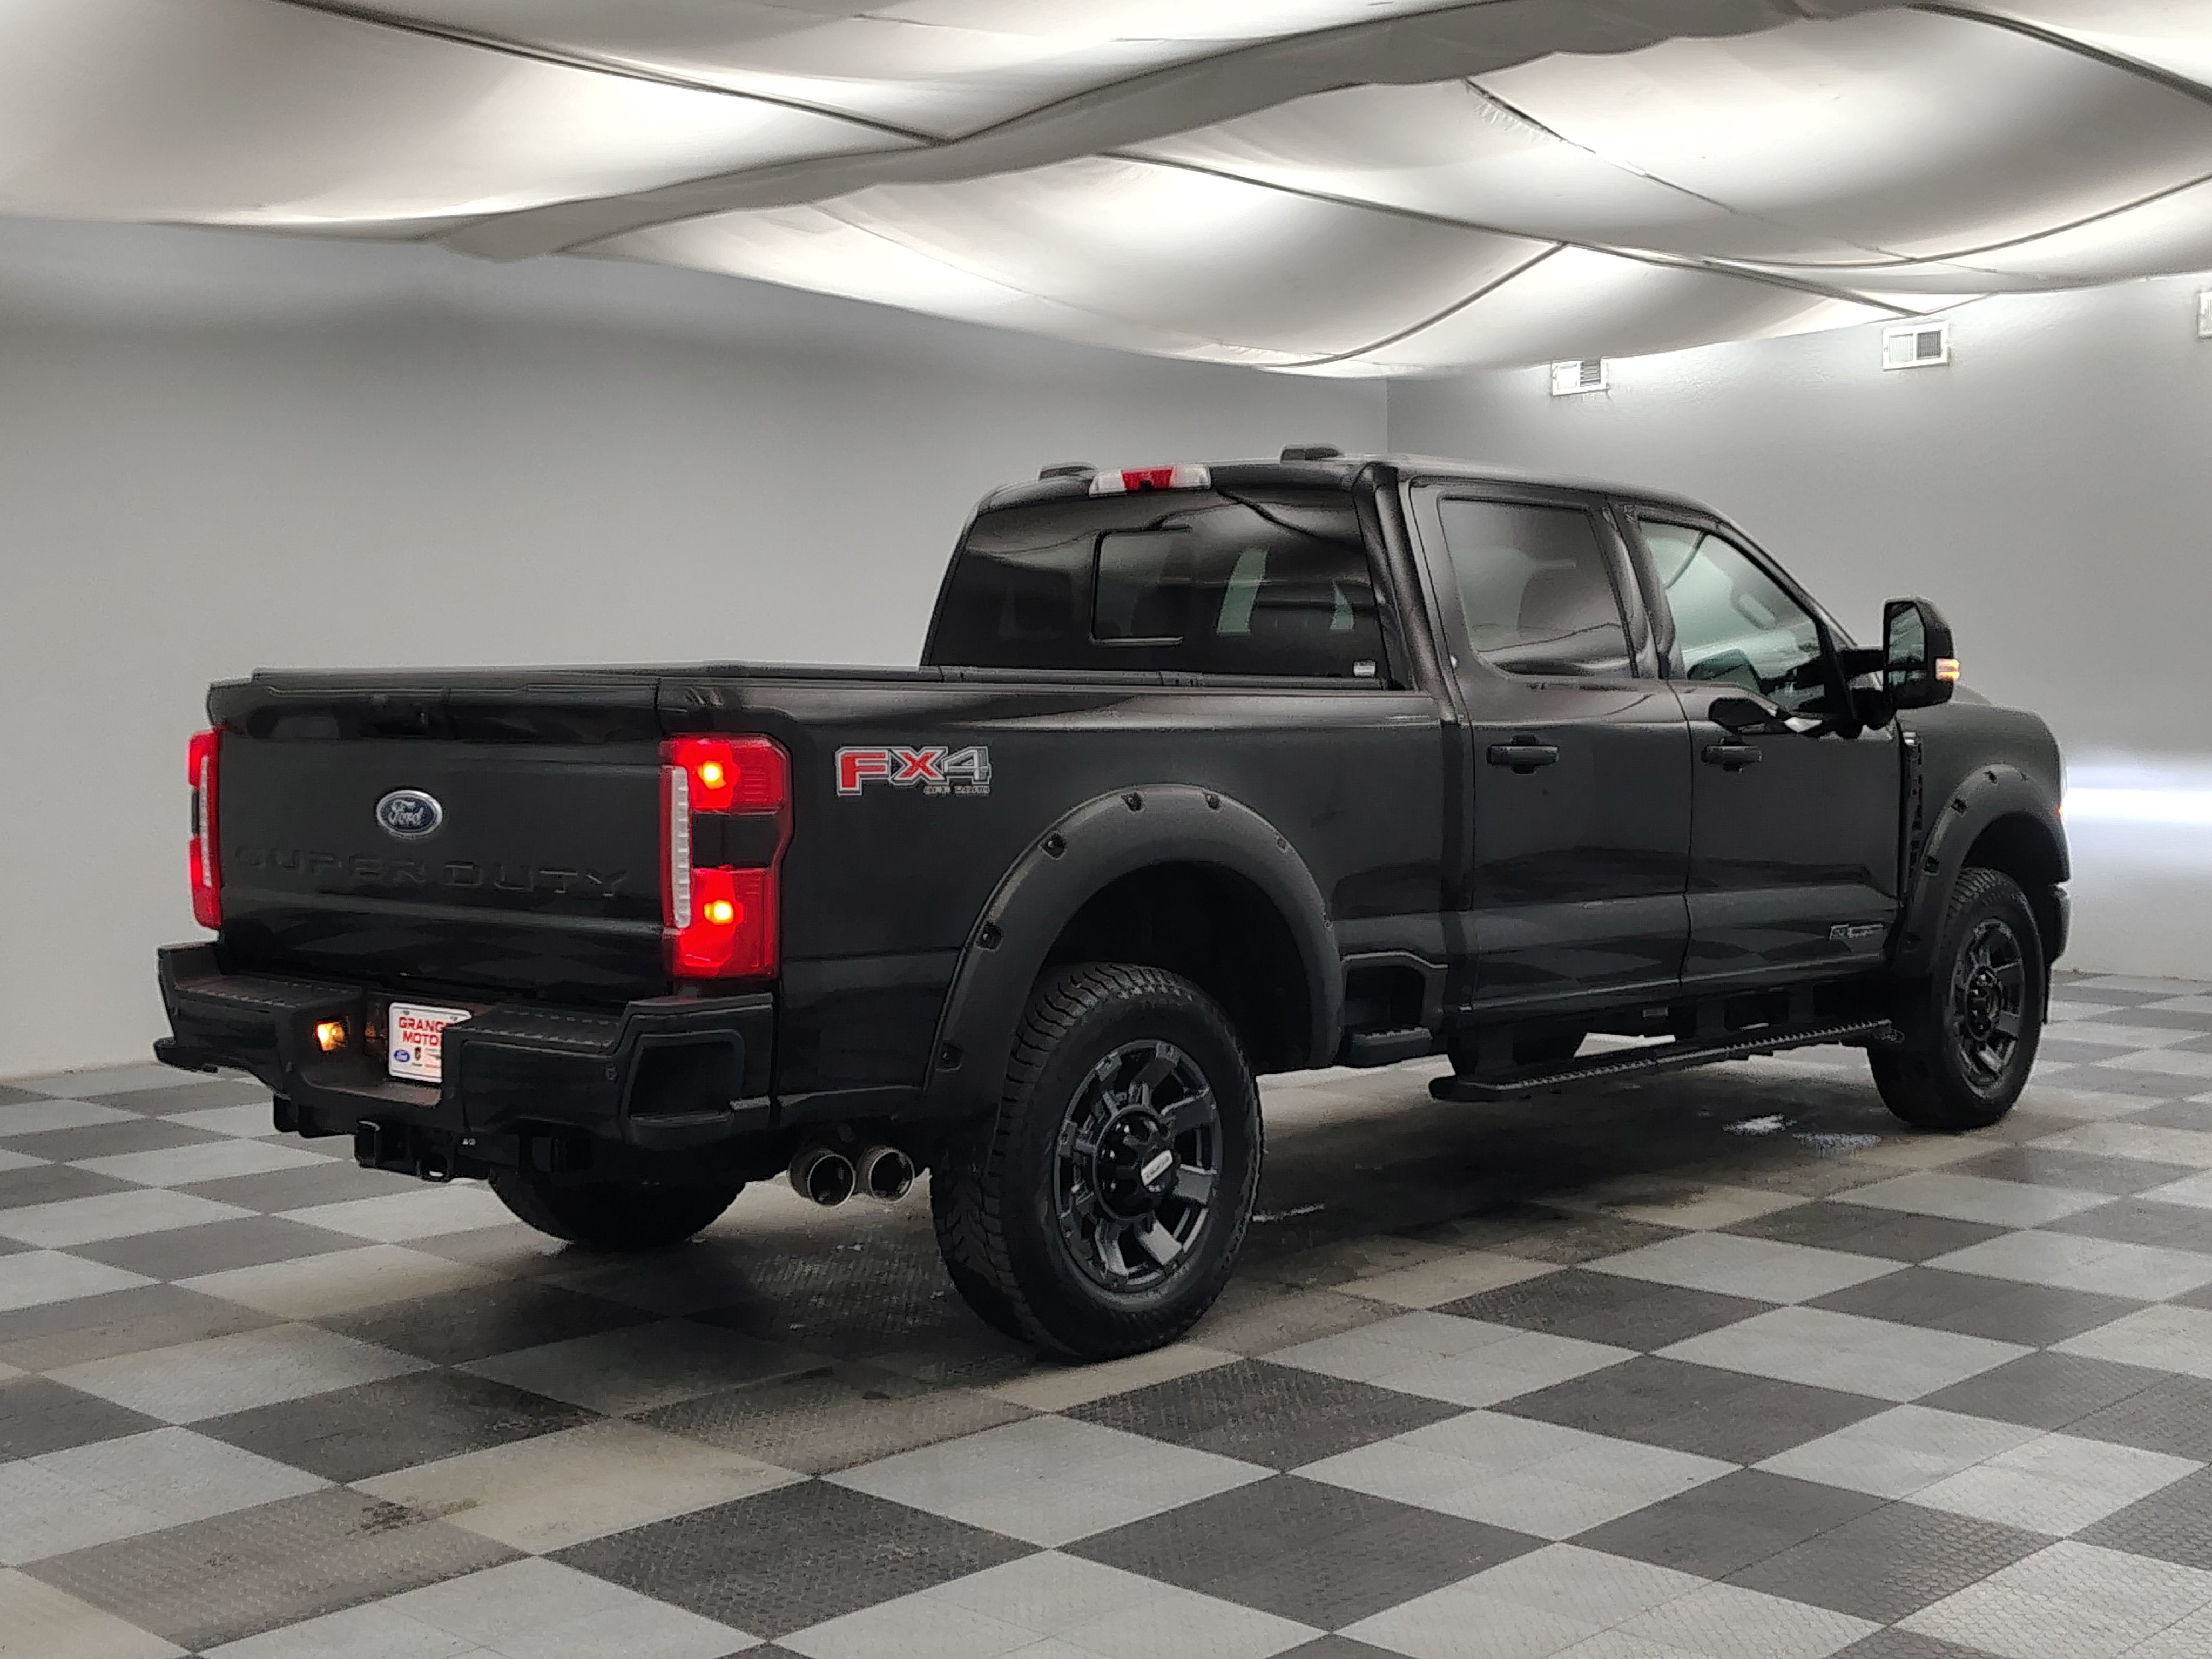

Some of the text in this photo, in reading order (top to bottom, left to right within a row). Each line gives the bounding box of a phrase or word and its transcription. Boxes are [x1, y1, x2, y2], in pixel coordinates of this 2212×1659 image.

[835, 746, 991, 797] FX4
[388, 799, 424, 827] Ford
[236, 845, 628, 898] SUPER DUTY
[399, 1017, 453, 1033] GRANG
